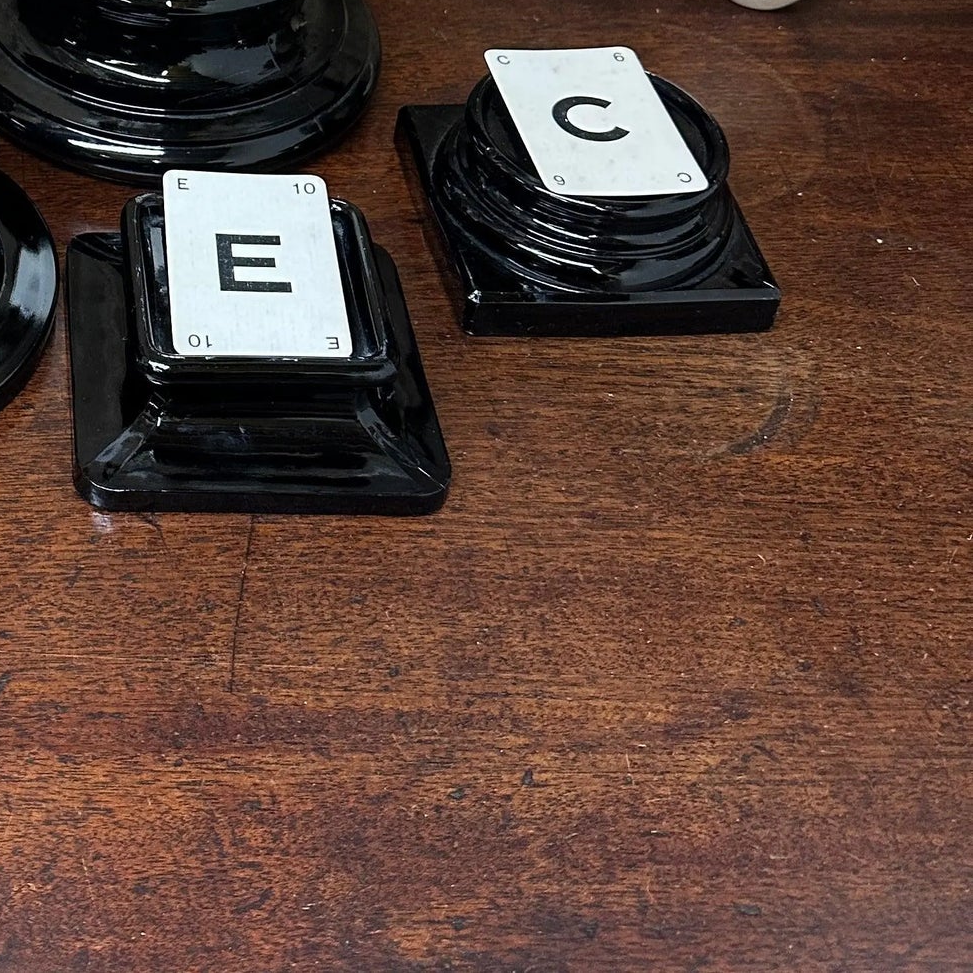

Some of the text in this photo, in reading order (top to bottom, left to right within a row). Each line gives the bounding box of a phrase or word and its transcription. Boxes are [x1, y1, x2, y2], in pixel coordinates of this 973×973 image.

[496, 54, 511, 66] C
[612, 52, 625, 63] 6
[551, 95, 631, 143] C
[177, 177, 190, 191] E
[676, 172, 692, 184] C
[292, 182, 316, 195] 10
[214, 232, 293, 294] E
[188, 334, 213, 348] 10
[325, 336, 340, 350] E
